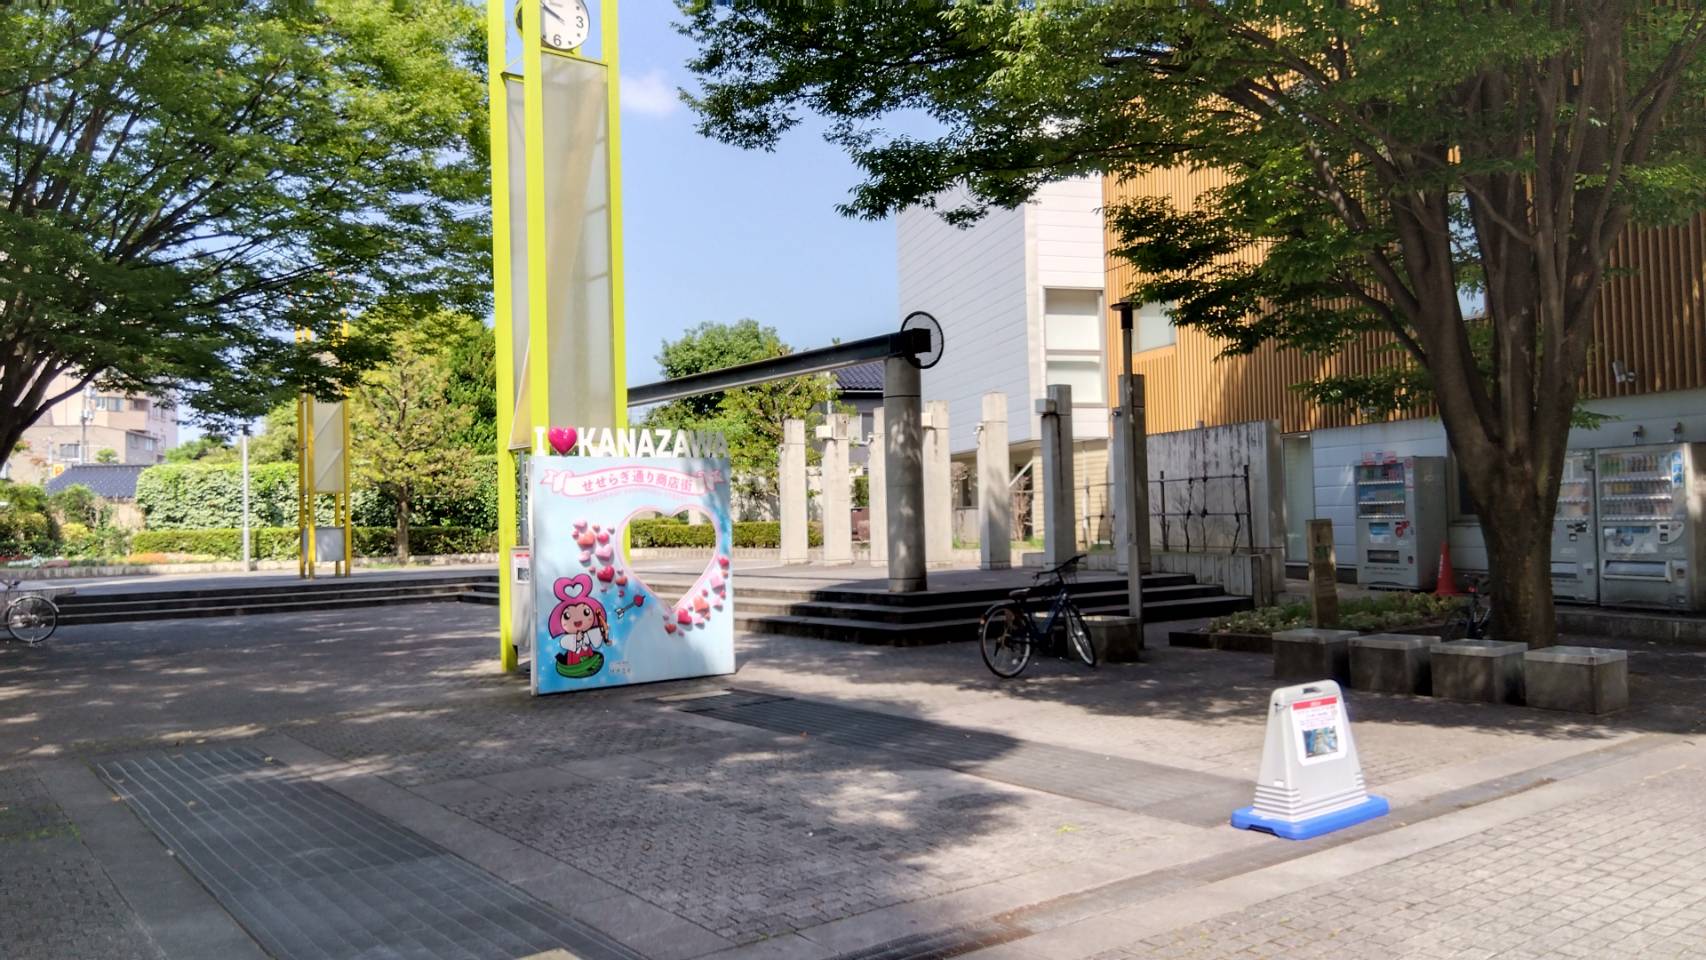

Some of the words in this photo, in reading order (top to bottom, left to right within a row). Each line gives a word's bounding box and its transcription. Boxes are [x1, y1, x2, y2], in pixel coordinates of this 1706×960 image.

[576, 16, 584, 29] 3
[553, 34, 562, 47] 6
[534, 426, 546, 457] I
[578, 427, 728, 457] KANAZAWA
[582, 469, 692, 491] せせらぎ通り商店街
